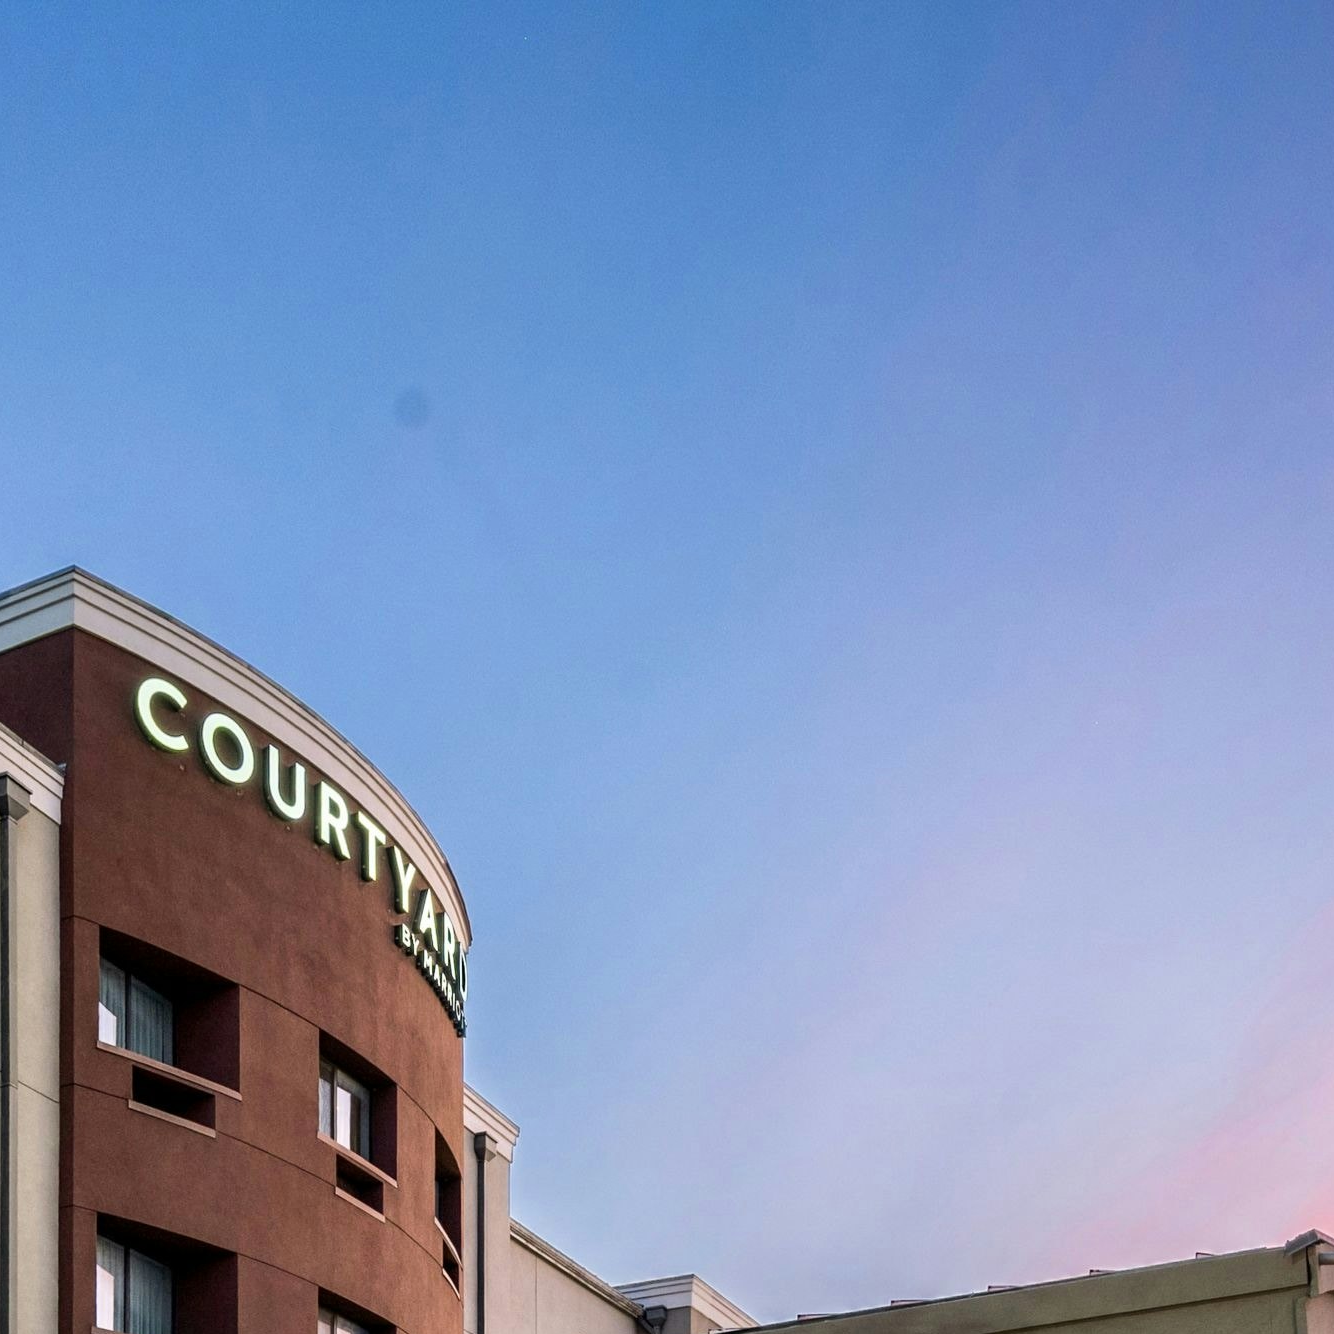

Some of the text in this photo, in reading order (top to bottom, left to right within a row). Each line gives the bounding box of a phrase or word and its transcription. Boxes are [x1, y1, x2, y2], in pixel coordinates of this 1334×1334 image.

[135, 676, 469, 1002] COURTYARD
[399, 922, 468, 1031] BY MARRIOT
